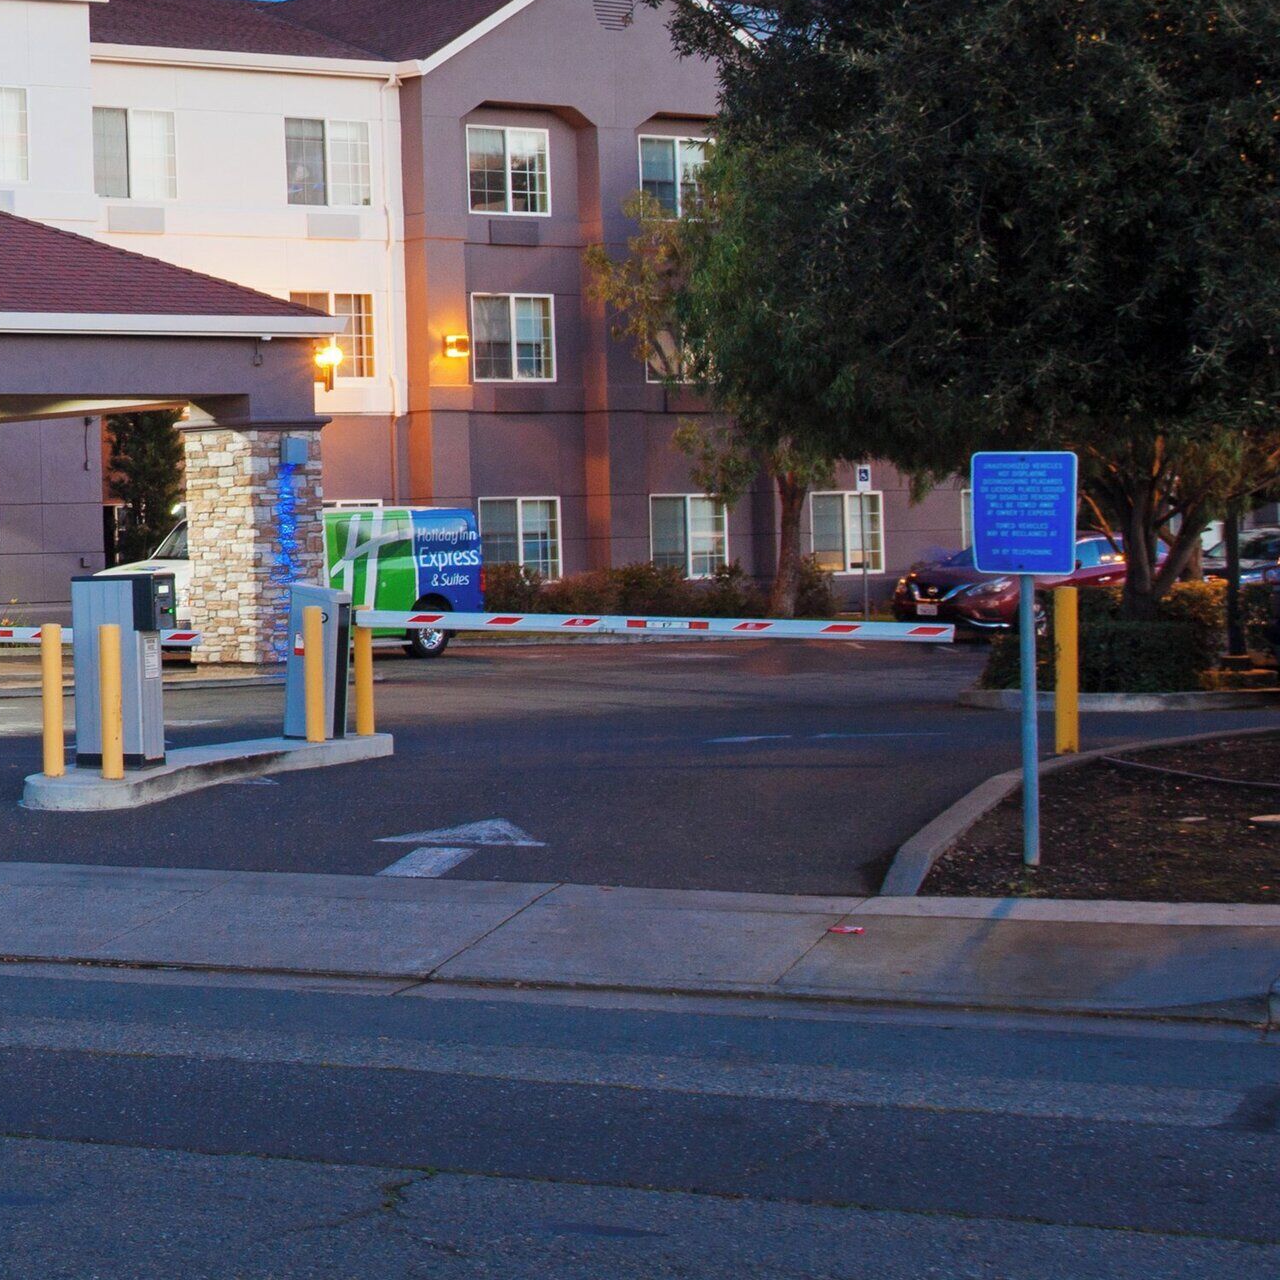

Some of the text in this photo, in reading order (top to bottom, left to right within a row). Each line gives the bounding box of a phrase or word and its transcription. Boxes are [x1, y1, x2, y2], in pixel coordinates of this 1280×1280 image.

[417, 527, 477, 545] Holiday Inn
[419, 548, 480, 570] Express
[431, 572, 469, 587] & Suites
